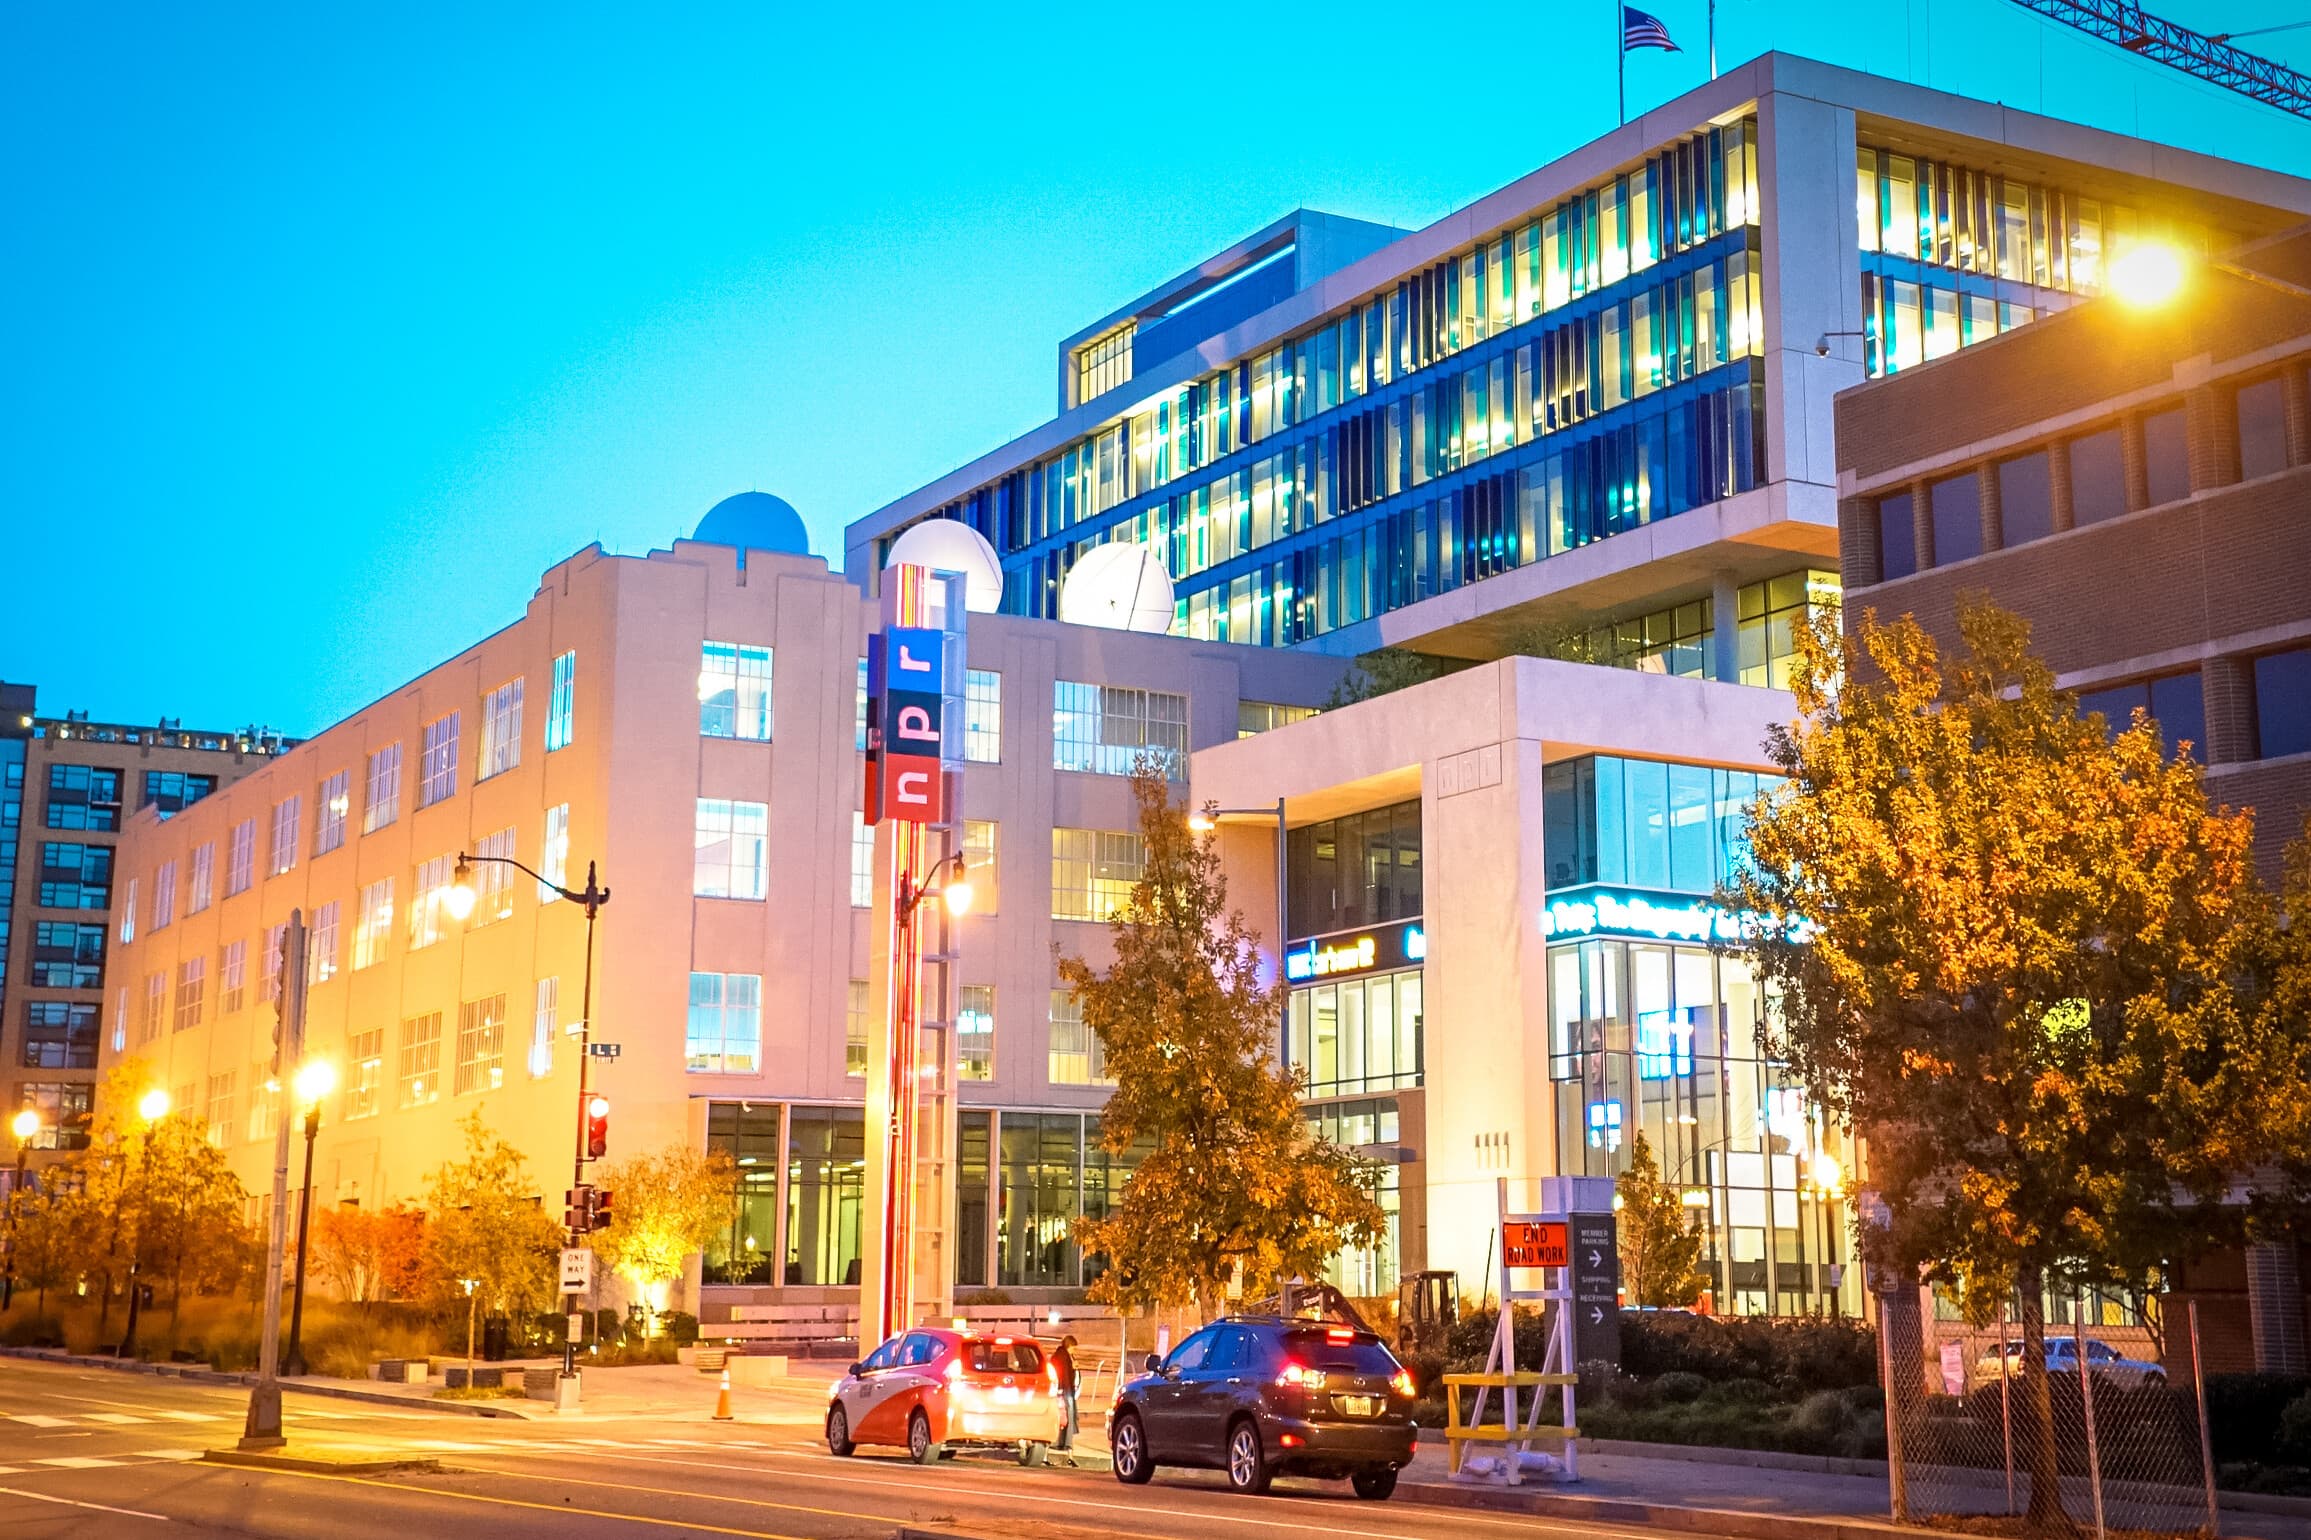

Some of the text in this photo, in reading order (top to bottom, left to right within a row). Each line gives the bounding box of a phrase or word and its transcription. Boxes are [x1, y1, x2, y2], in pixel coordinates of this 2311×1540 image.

[898, 645, 939, 804] npr
[1523, 1227, 1548, 1243] END
[1581, 1238, 1609, 1246] PARKING
[567, 1254, 585, 1262] ONE
[1507, 1246, 1564, 1263] ROAD WORK
[567, 1265, 585, 1273] WAY
